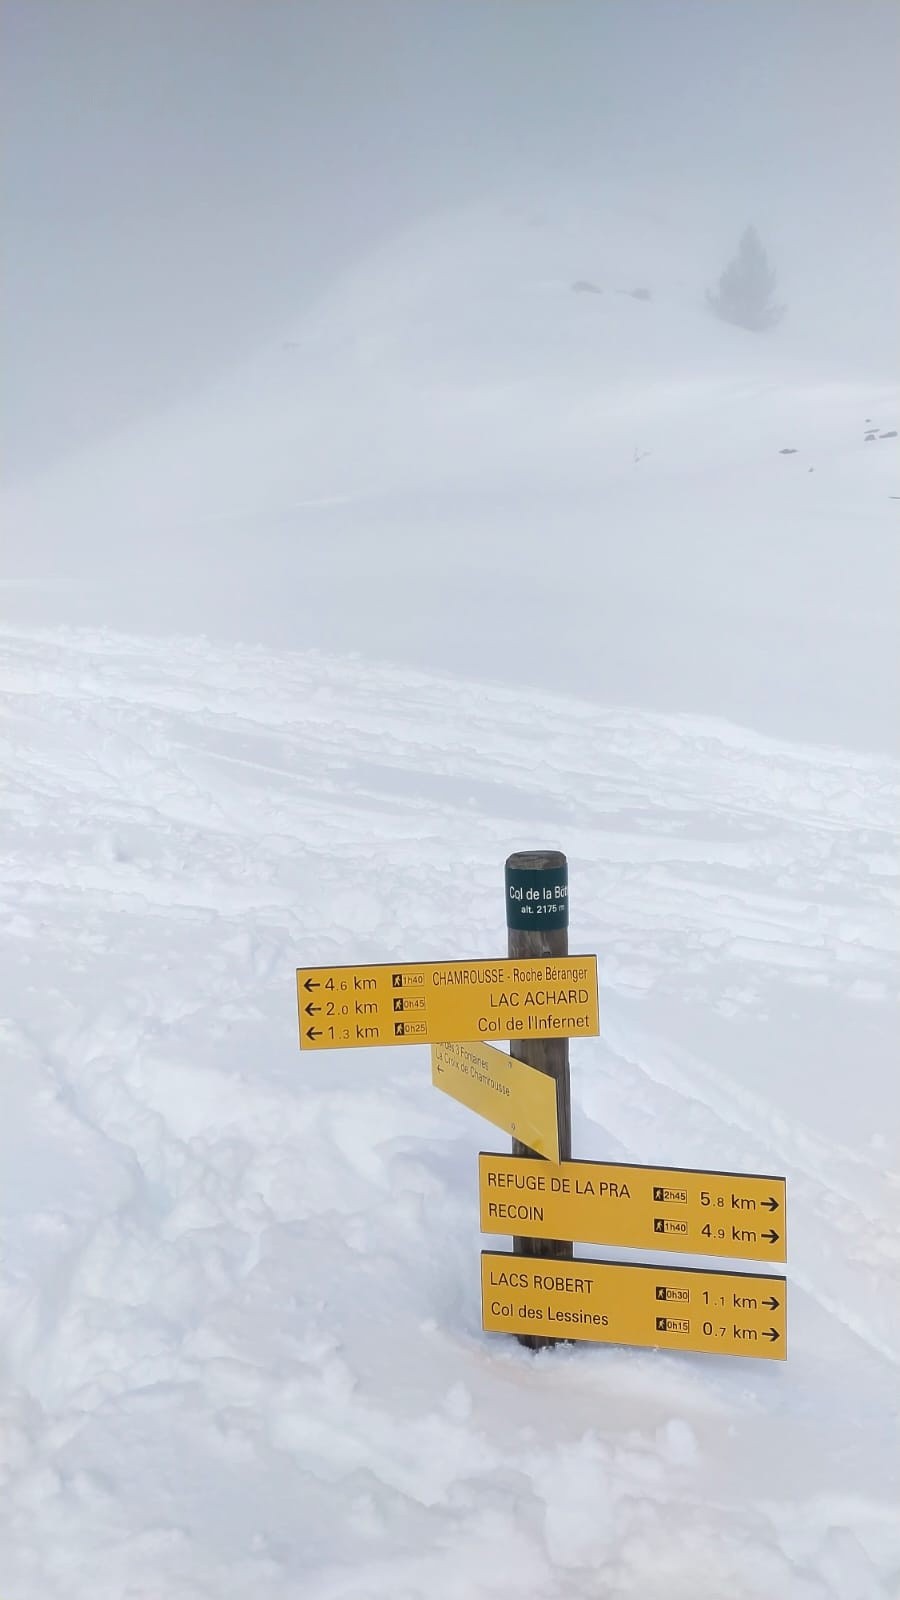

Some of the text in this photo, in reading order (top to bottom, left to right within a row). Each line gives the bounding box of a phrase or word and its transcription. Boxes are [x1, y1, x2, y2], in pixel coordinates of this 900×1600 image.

[509, 886, 523, 900] Col
[526, 888, 540, 901] de
[543, 887, 552, 900] la
[521, 905, 534, 914] alt.
[536, 904, 558, 915] 2175
[324, 976, 377, 992] 4.6 km
[403, 975, 423, 985] 1h40
[432, 968, 504, 986] CHAMROUSSE
[513, 968, 542, 983] Roche
[545, 966, 588, 983] Béranger
[404, 999, 425, 1009] 0h45
[490, 989, 589, 1008] LAC ACHARD
[325, 1000, 378, 1016] 2.0 km
[404, 1023, 426, 1033] 0h25
[478, 1014, 590, 1032] Col de l'Infernet
[327, 1024, 379, 1040] 1.3 km
[470, 1065, 510, 1097] Chamrousse
[487, 1172, 631, 1199] REFUGE DE LA PRA
[664, 1192, 686, 1201] 2h45
[700, 1191, 756, 1210] 5.8 km
[488, 1203, 544, 1222] RECOIN
[665, 1223, 686, 1232] 1h40
[701, 1224, 757, 1242] 4.9 km
[490, 1272, 594, 1294] LACS ROBERT
[666, 1290, 688, 1300] 0h30
[702, 1291, 757, 1309] 1.1 km
[491, 1302, 609, 1326] Col des Lessines
[667, 1321, 689, 1331] 0h15
[703, 1322, 757, 1340] 0.7 km
